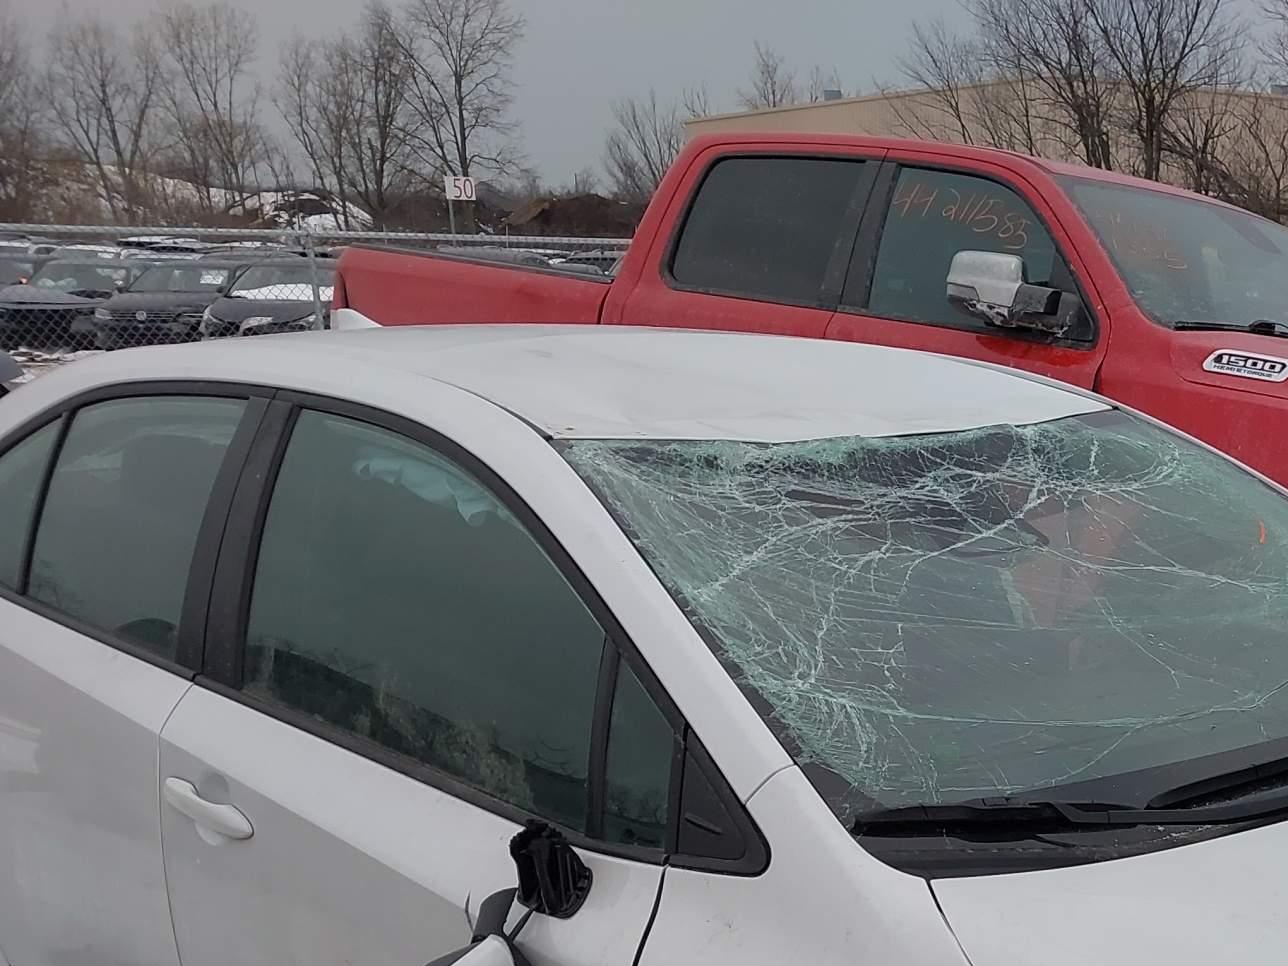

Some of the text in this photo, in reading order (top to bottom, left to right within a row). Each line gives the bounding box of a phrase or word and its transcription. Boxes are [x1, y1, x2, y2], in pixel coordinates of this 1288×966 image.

[453, 178, 474, 199] 50
[1213, 364, 1236, 373] HEMI
[1220, 354, 1284, 373] 1500
